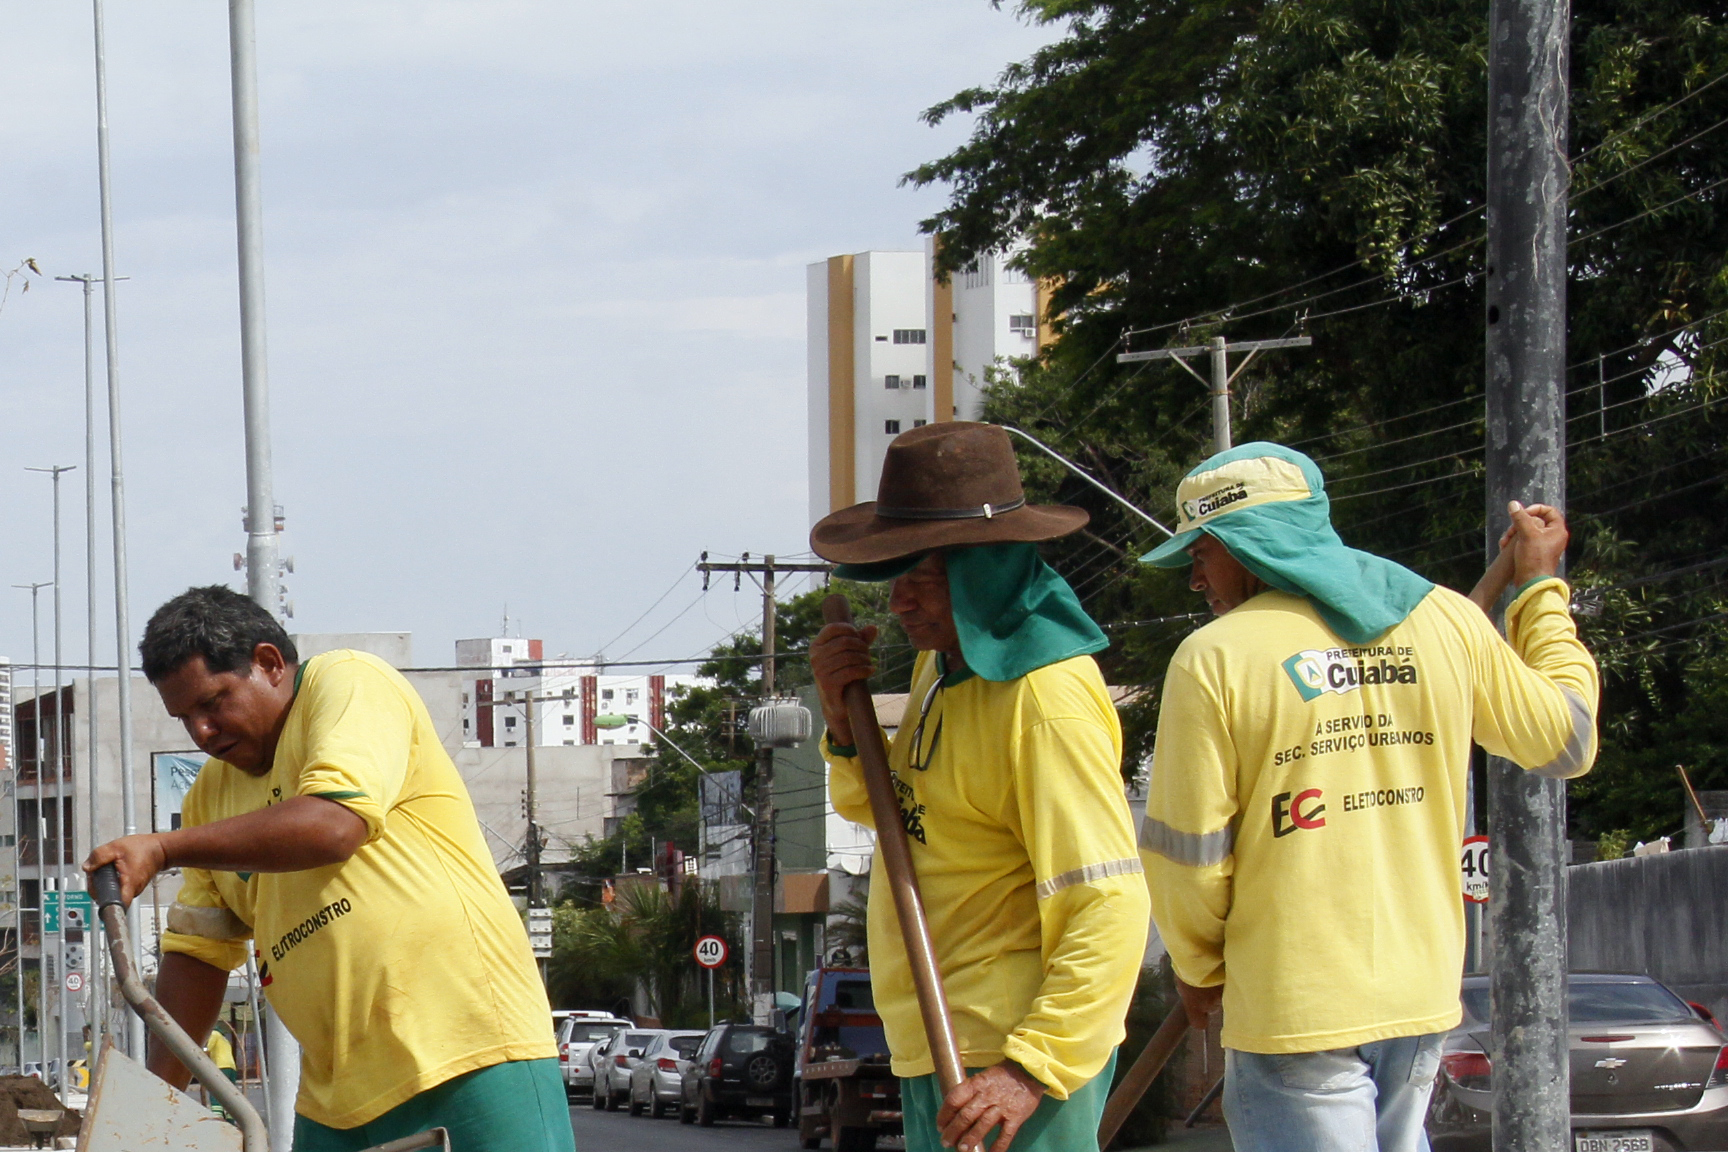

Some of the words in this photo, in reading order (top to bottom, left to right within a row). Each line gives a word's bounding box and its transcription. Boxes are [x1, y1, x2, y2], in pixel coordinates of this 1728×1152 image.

[1326, 646, 1394, 661] PREFEITURA
[1397, 646, 1413, 656] DE
[1327, 657, 1418, 689] Cuiabá
[1377, 713, 1394, 728] DA
[1274, 745, 1306, 767] SEC.
[1310, 733, 1366, 757] SERVIÇO
[1368, 731, 1434, 748] URBANOS
[1271, 788, 1327, 838] EC
[1461, 848, 1489, 878] 40
[699, 941, 719, 956] 40
[68, 977, 79, 985] 40
